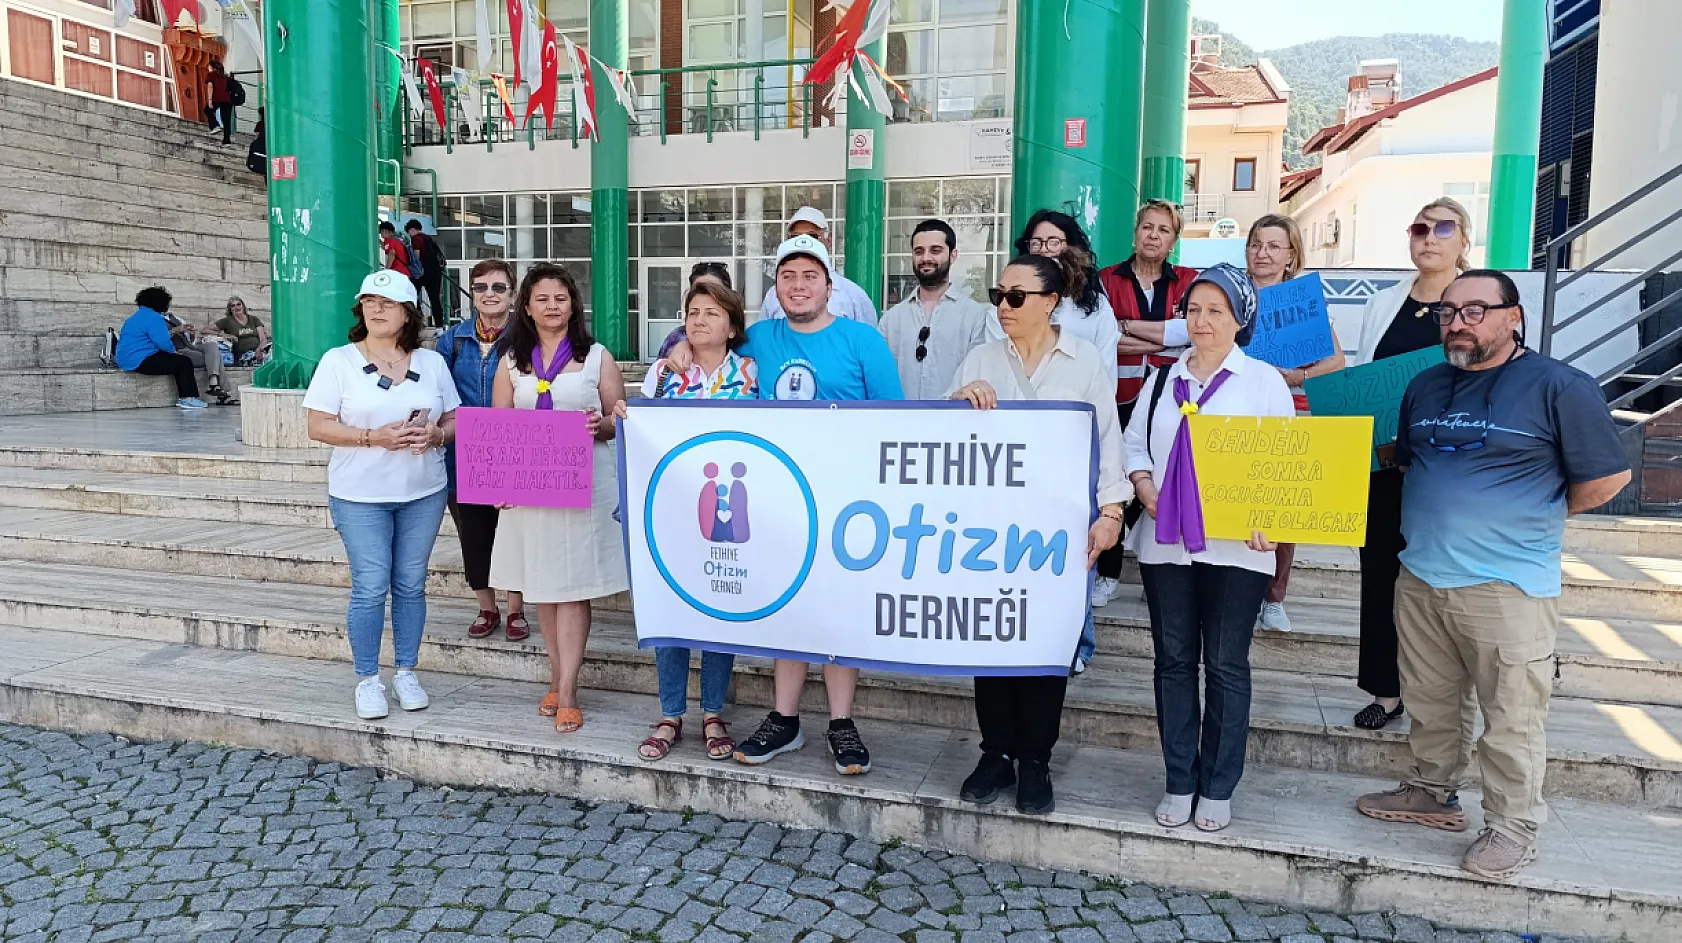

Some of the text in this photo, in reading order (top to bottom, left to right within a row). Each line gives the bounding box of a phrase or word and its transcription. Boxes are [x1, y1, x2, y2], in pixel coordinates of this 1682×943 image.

[1204, 428, 1310, 456] BENDEN
[463, 443, 589, 468] YAŞAM HERKES
[878, 432, 1027, 488] FETHİYE
[1246, 460, 1323, 482] SONRA
[1201, 483, 1314, 507] ÇOCUĞUMA
[1246, 509, 1277, 530] NE
[831, 499, 1068, 580] Otizm
[703, 560, 748, 578] Otizm
[875, 587, 1028, 642] DERNEĞİ
